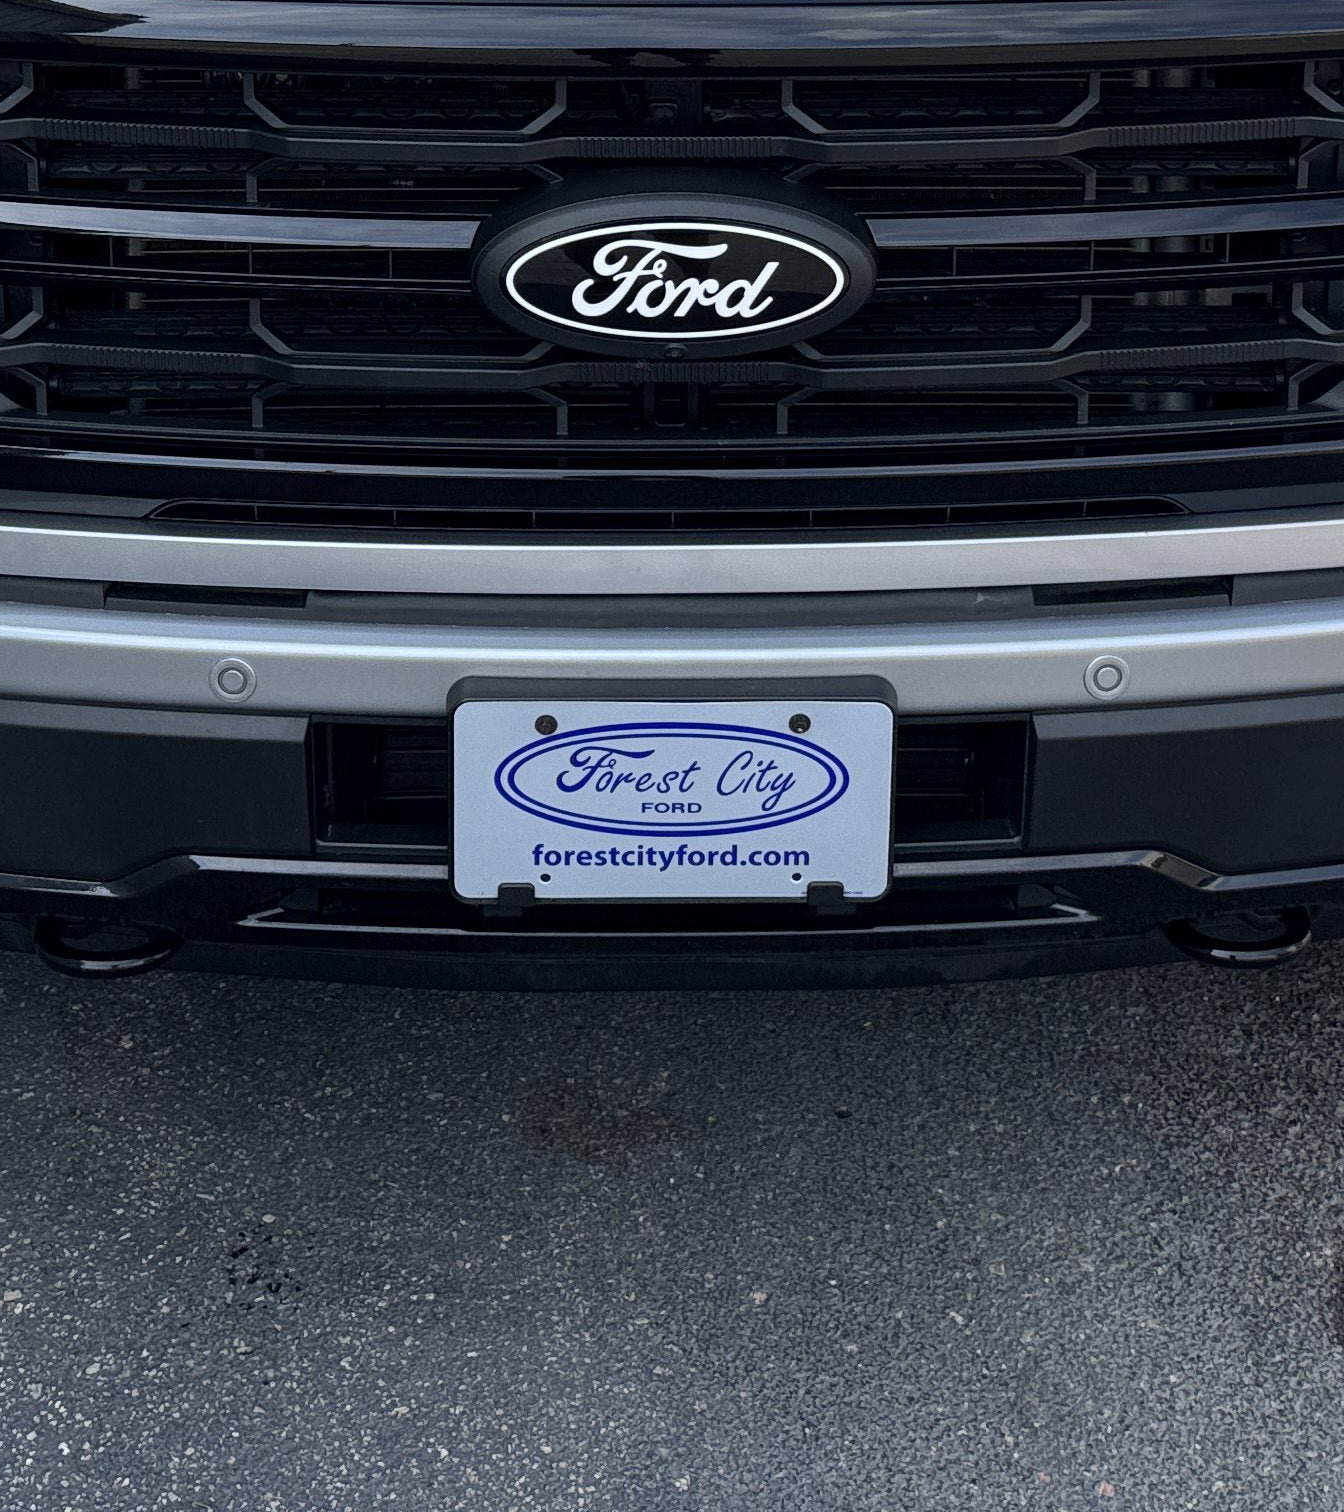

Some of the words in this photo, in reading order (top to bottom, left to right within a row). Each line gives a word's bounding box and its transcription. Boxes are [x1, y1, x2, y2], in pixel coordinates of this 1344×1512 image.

[571, 239, 780, 318] Ford
[556, 745, 702, 794] Forest
[716, 750, 796, 812] City
[641, 802, 703, 814] FORD
[532, 843, 810, 872] forestcityford.com
